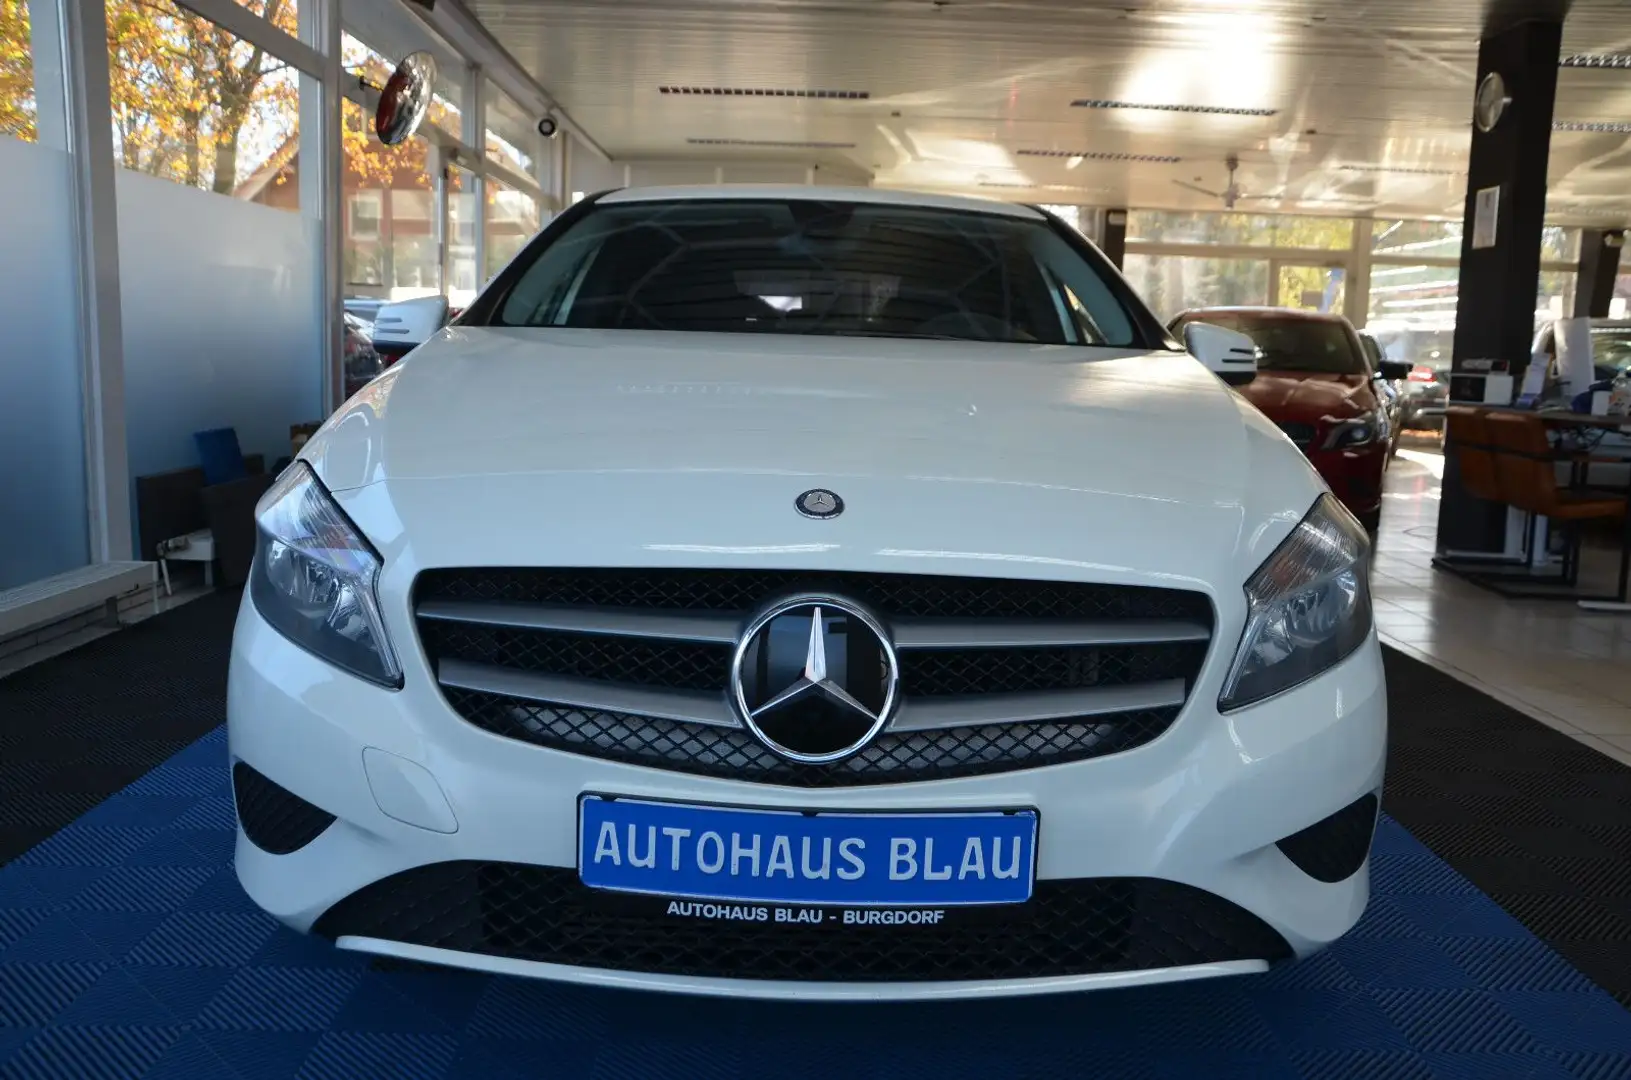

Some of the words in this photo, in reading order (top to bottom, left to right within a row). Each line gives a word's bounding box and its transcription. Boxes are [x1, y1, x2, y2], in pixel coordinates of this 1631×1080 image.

[594, 821, 866, 880] AUTOHAUS
[889, 836, 1021, 881] BLAU
[667, 901, 768, 921] AUTOHAUS
[774, 908, 822, 924] BLAU
[843, 910, 945, 925] BURGDORF
